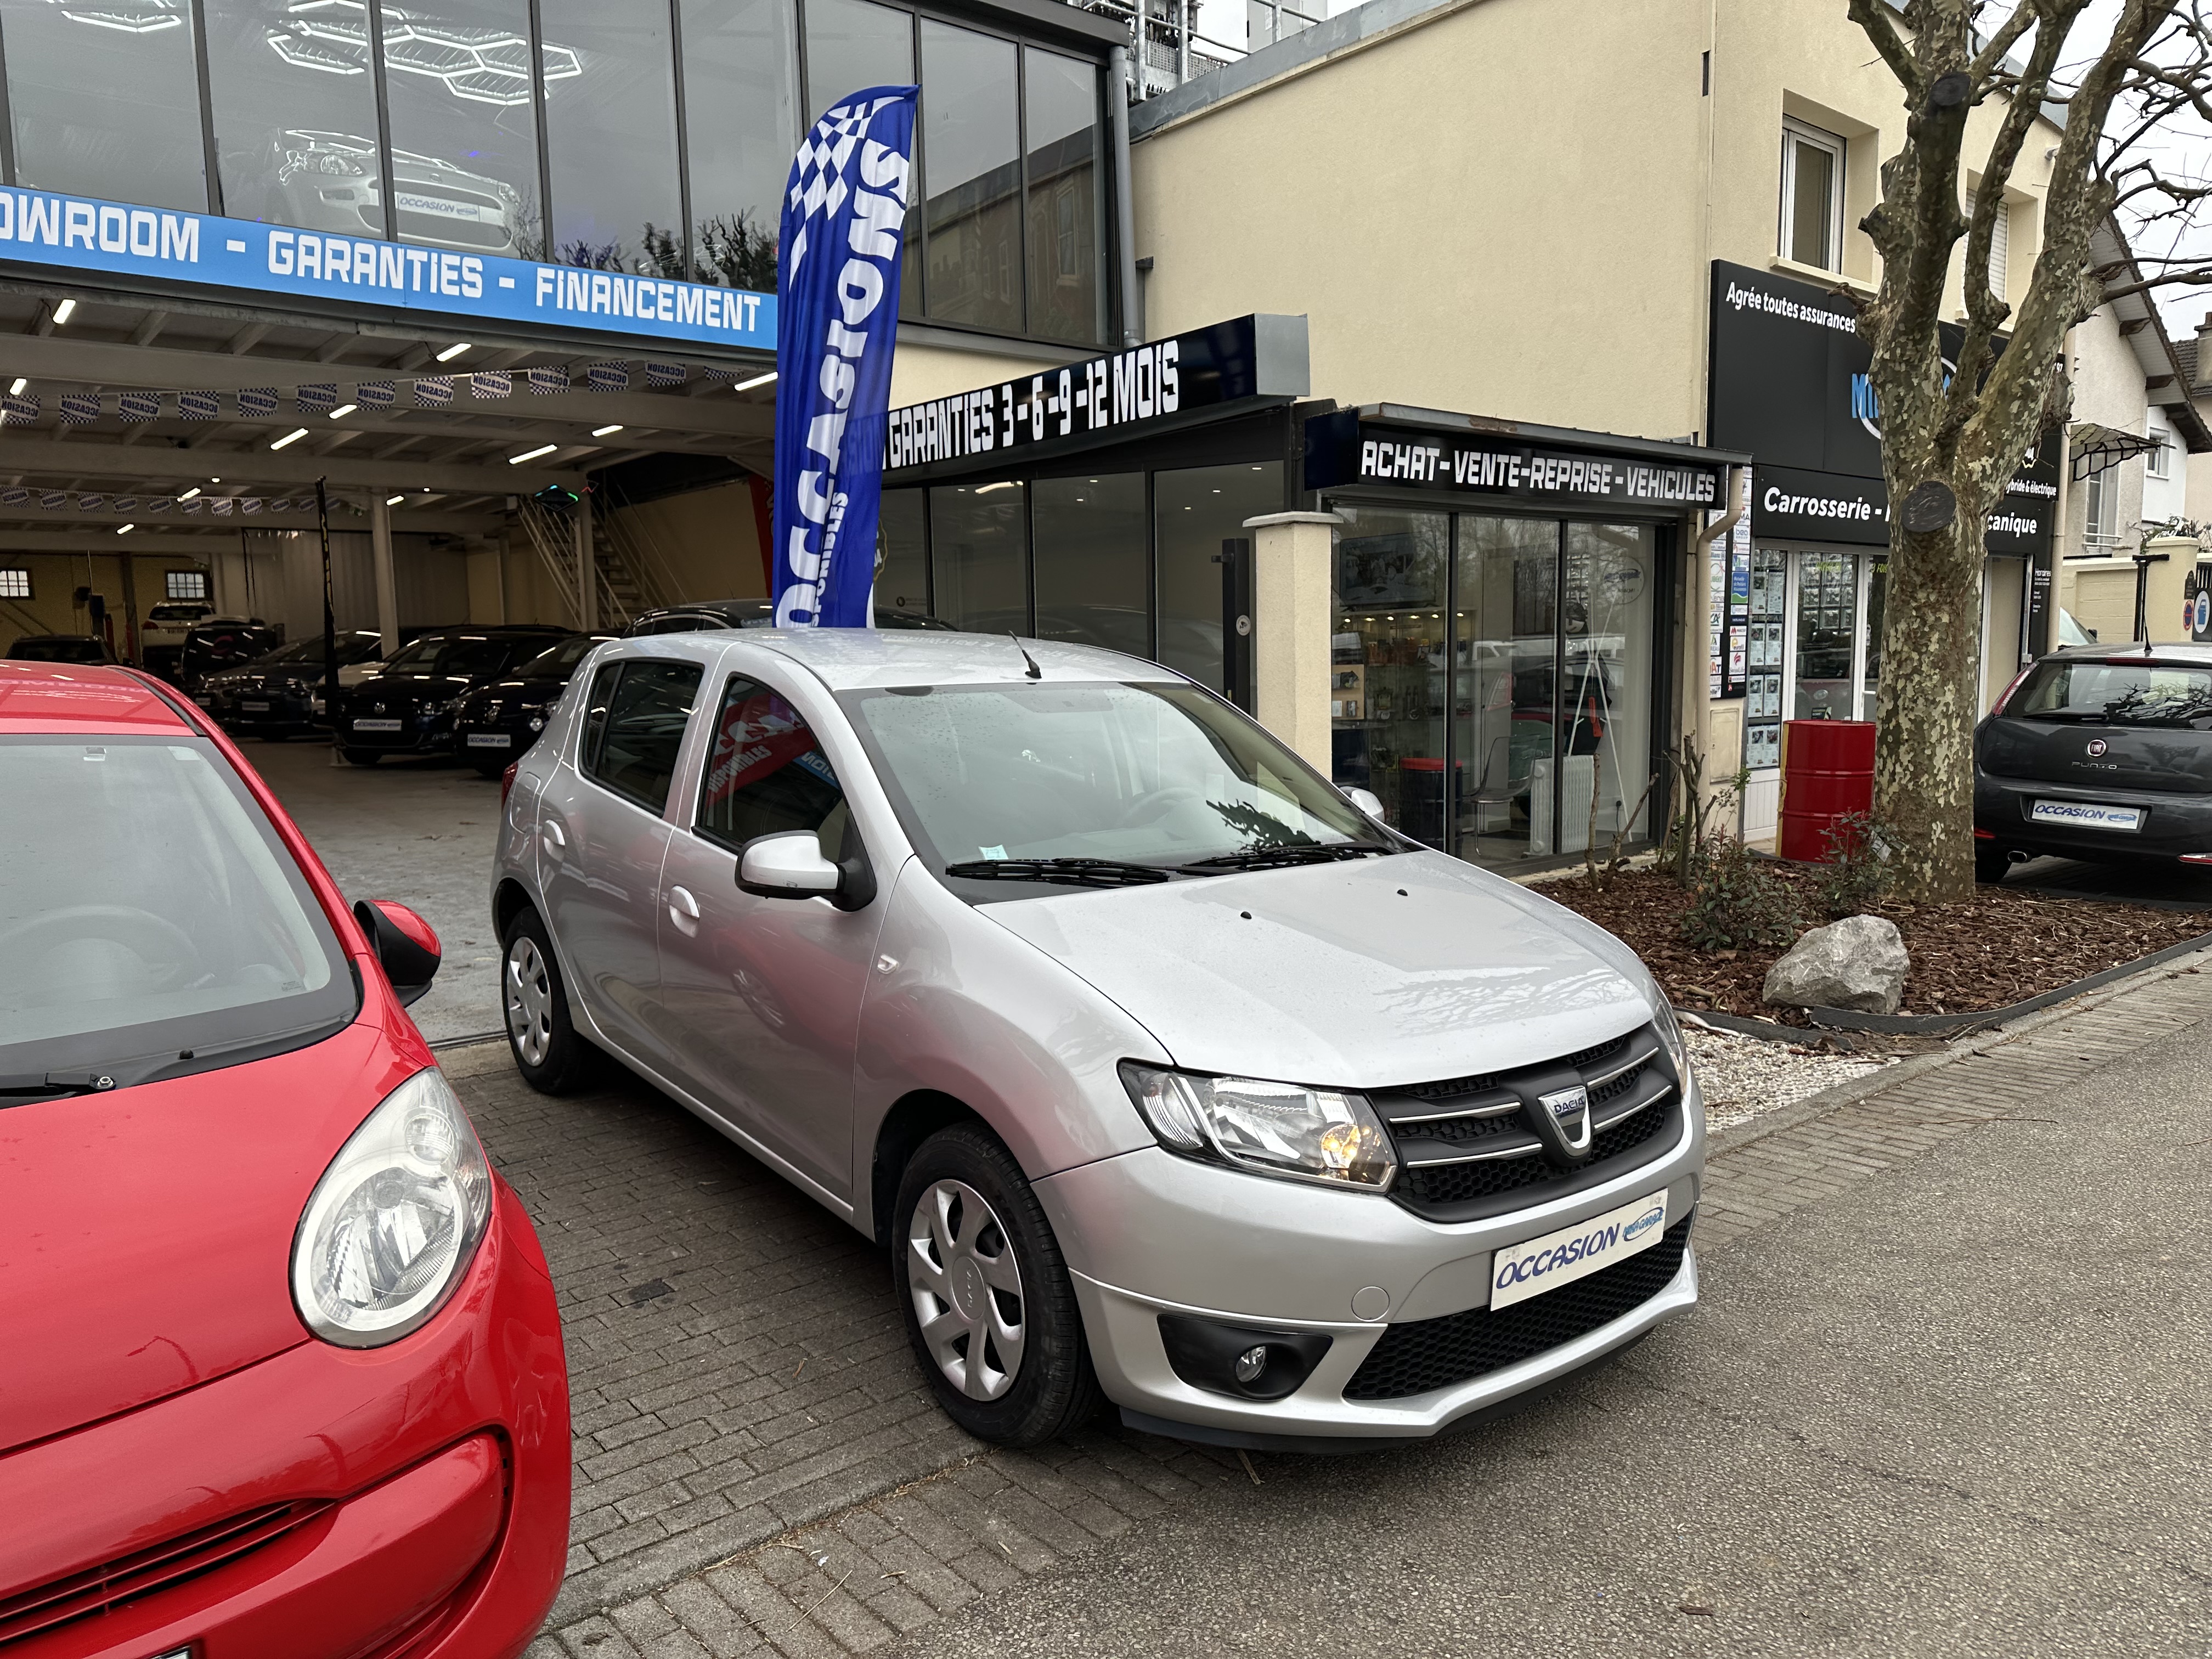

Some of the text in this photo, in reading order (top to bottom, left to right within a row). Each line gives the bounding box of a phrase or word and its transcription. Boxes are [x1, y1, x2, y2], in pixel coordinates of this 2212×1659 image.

[400, 197, 455, 212] OCCASION
[268, 230, 483, 298] GARANTIES
[535, 268, 761, 332] FINANCEMENT
[1726, 281, 1856, 334] Agrée toutes assurances
[890, 389, 994, 469] GARANTIES
[1113, 340, 1179, 425] MOIS
[2006, 478, 2025, 494] ybride
[2030, 480, 2057, 498] électrique
[1764, 487, 1871, 520] Carrosserie
[1988, 512, 2037, 538] canique
[2091, 744, 2102, 753] FIAT
[2072, 761, 2118, 770] PUNTO
[2035, 805, 2106, 819] OCCASION
[1554, 1097, 1585, 1113] DACIA
[1496, 1222, 1620, 1289] OCCASION
